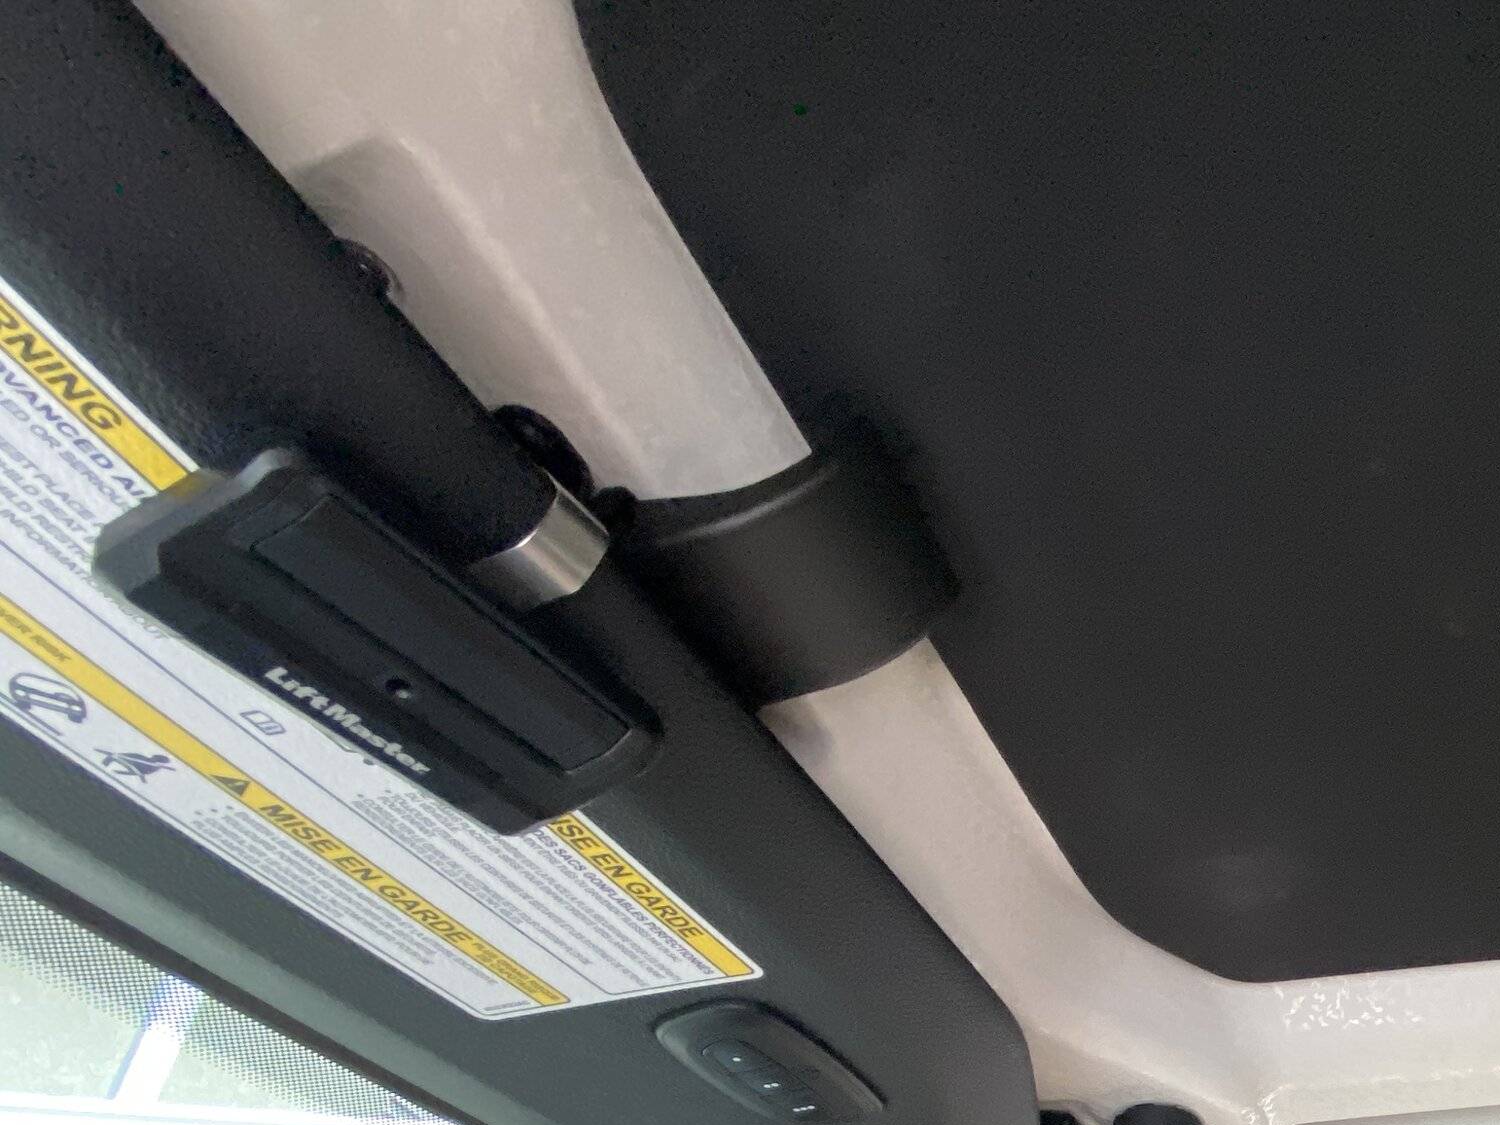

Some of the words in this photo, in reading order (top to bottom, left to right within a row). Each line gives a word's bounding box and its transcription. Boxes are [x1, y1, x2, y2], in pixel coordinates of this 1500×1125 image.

[263, 666, 431, 774] LiftMaster
[259, 804, 341, 854] MISE
[333, 856, 384, 881] EN
[379, 886, 474, 942] GARDE
[590, 854, 633, 877] EN
[626, 882, 704, 938] GARDE
